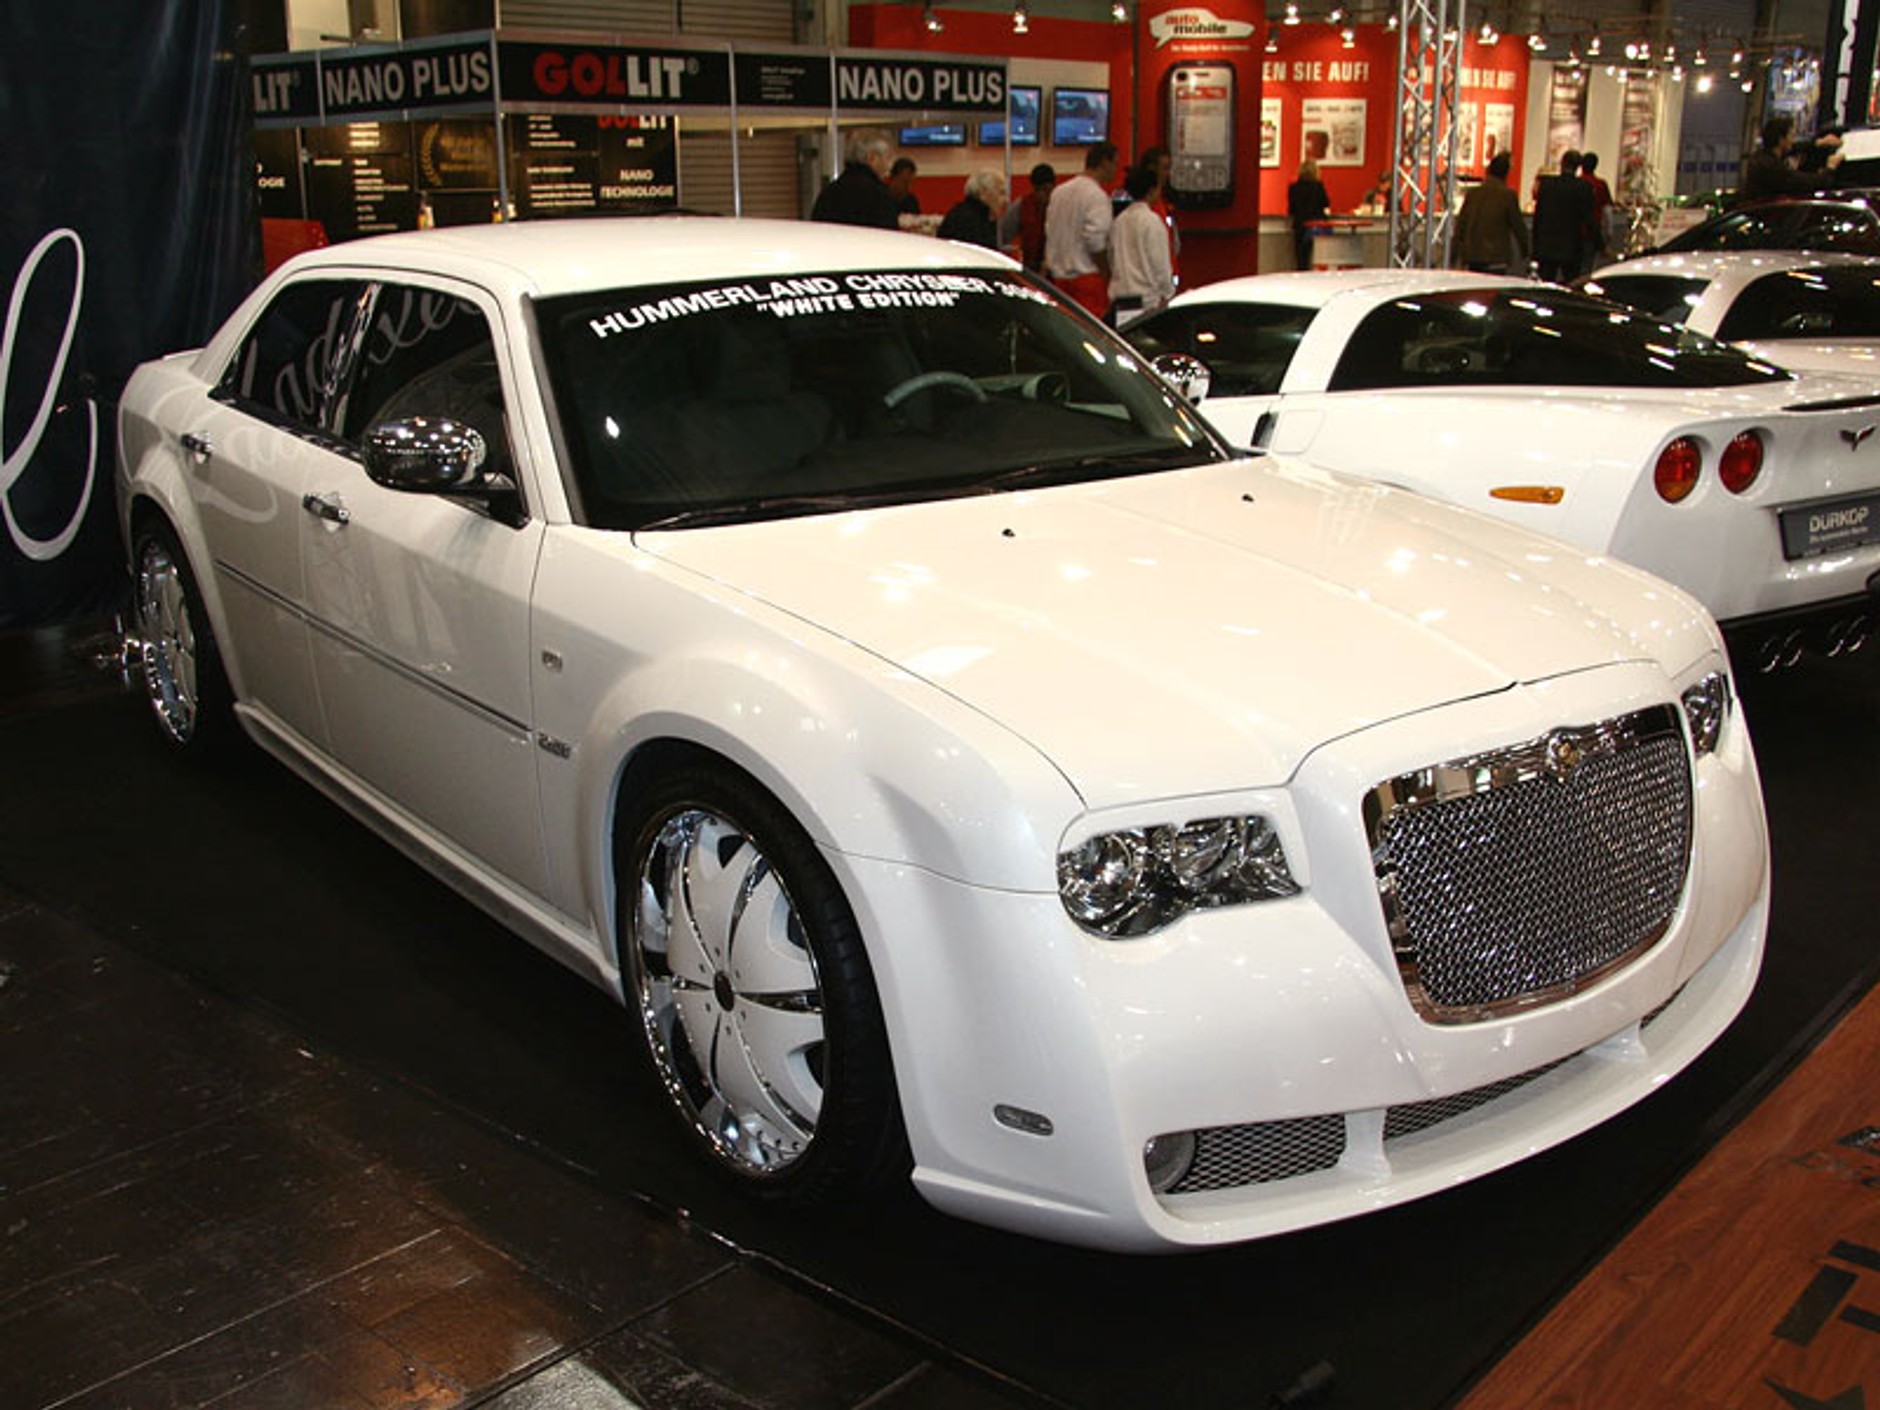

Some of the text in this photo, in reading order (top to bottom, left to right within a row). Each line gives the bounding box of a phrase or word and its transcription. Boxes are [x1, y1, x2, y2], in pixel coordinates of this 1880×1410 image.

[1173, 23, 1228, 34] mobile
[325, 51, 490, 106] NANO PLUS
[839, 65, 1003, 104] NANO PLUS
[1293, 61, 1323, 81] SIE
[1327, 61, 1370, 82] AUF!
[620, 168, 654, 182] NANO
[589, 276, 839, 338] HUMMERLAND
